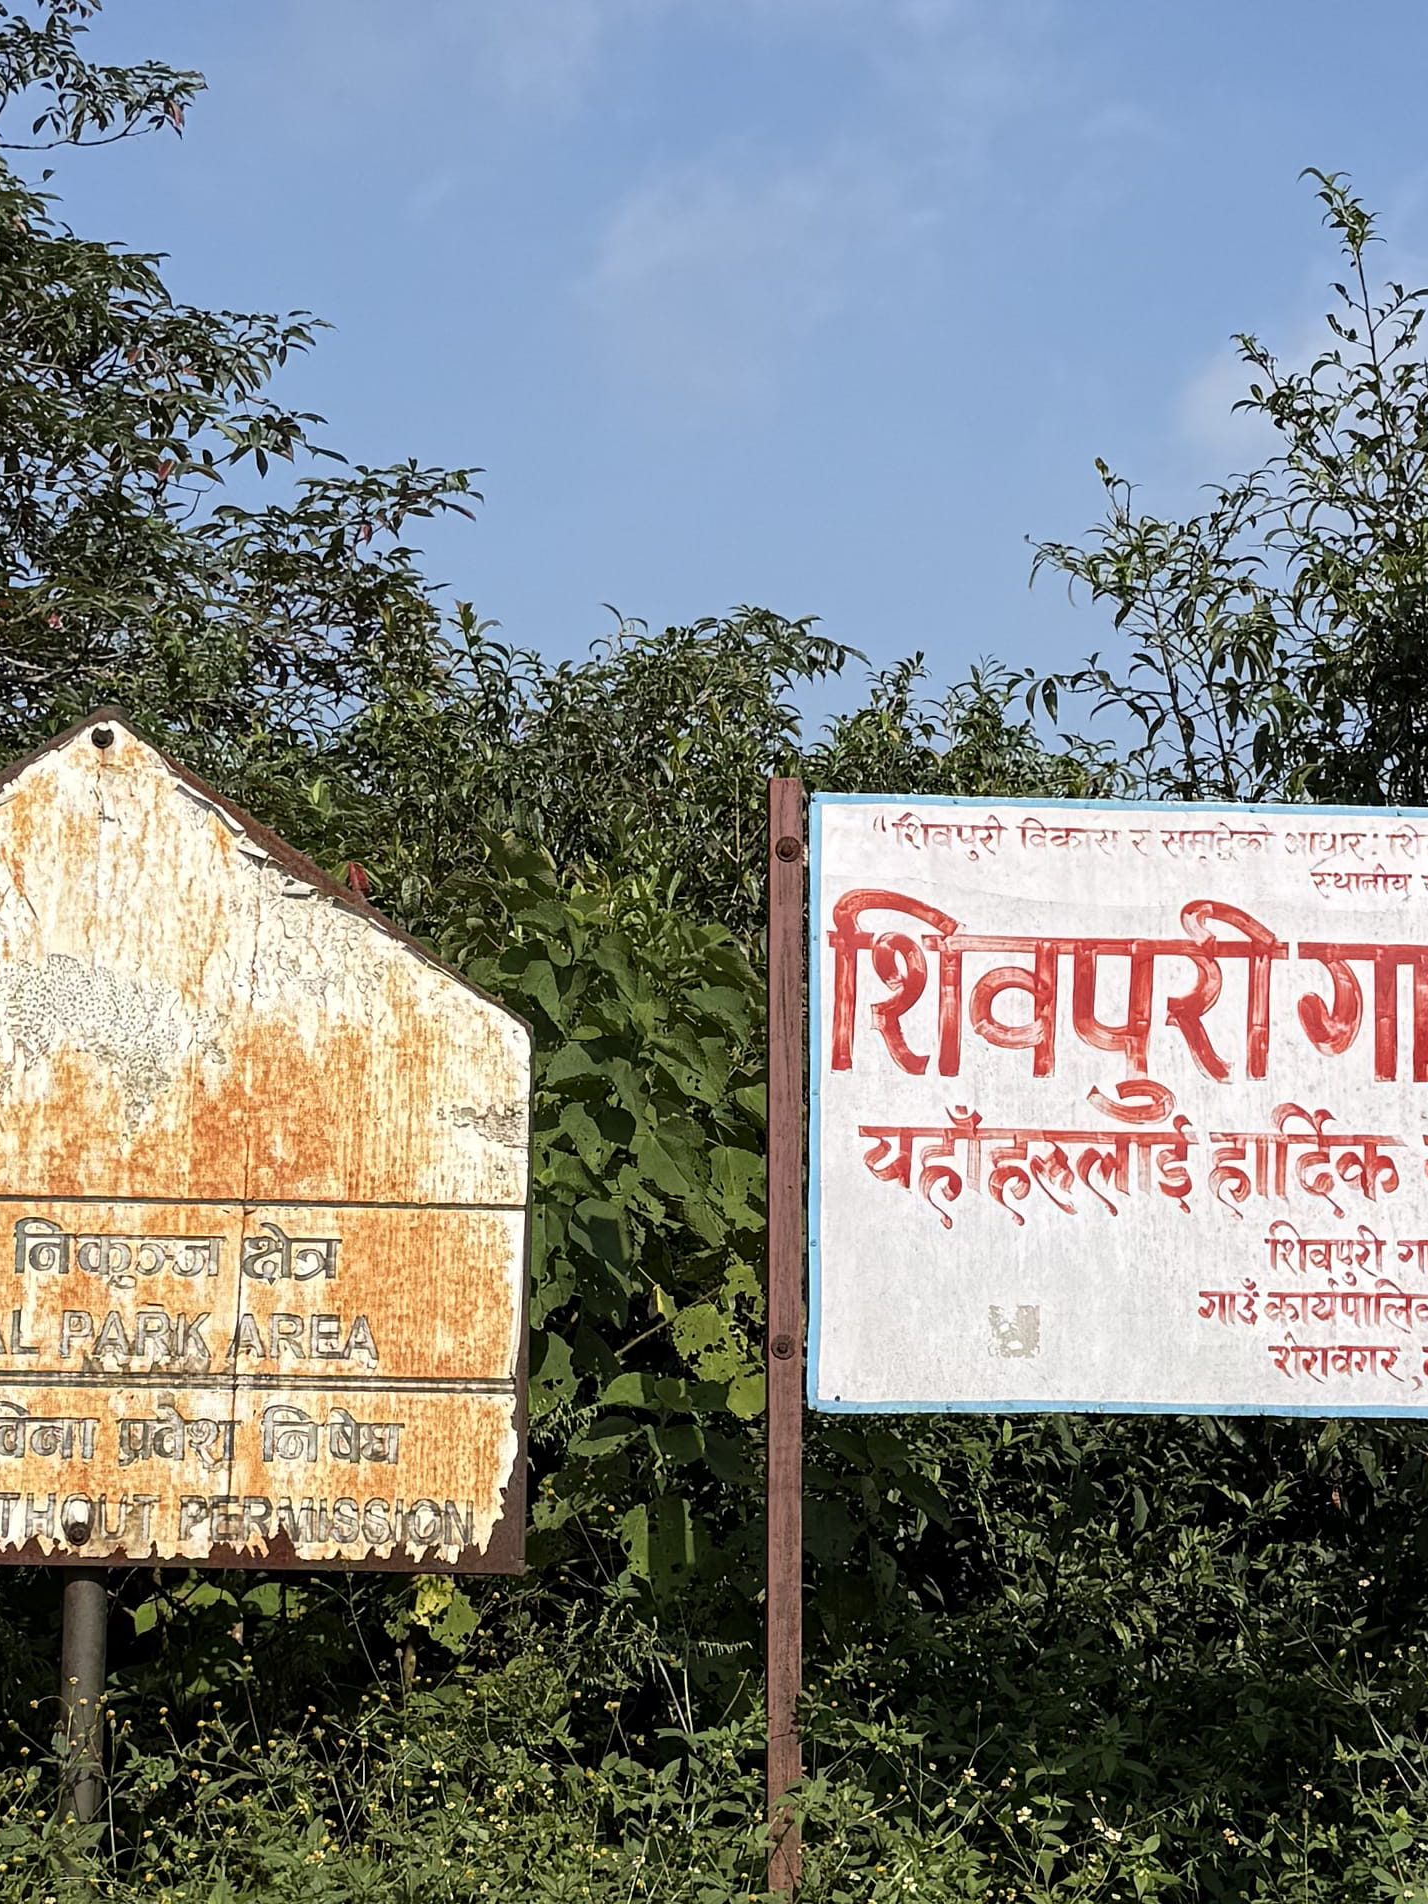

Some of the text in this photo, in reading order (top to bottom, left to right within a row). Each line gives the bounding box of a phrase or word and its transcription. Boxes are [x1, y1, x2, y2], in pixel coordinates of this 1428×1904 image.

[1129, 829, 1151, 856] र
[1310, 863, 1412, 899] स्थानीय
[827, 889, 1289, 1125] शिवपुरी
[1209, 1102, 1408, 1221] हार्दिक
[242, 1222, 343, 1285] क्षेत्र
[1198, 1277, 1261, 1326] गाउँ
[59, 1309, 212, 1359] PARK
[226, 1312, 379, 1360] AREA
[117, 1396, 243, 1472] प्रवेश
[178, 1494, 474, 1548] PERMISSION
